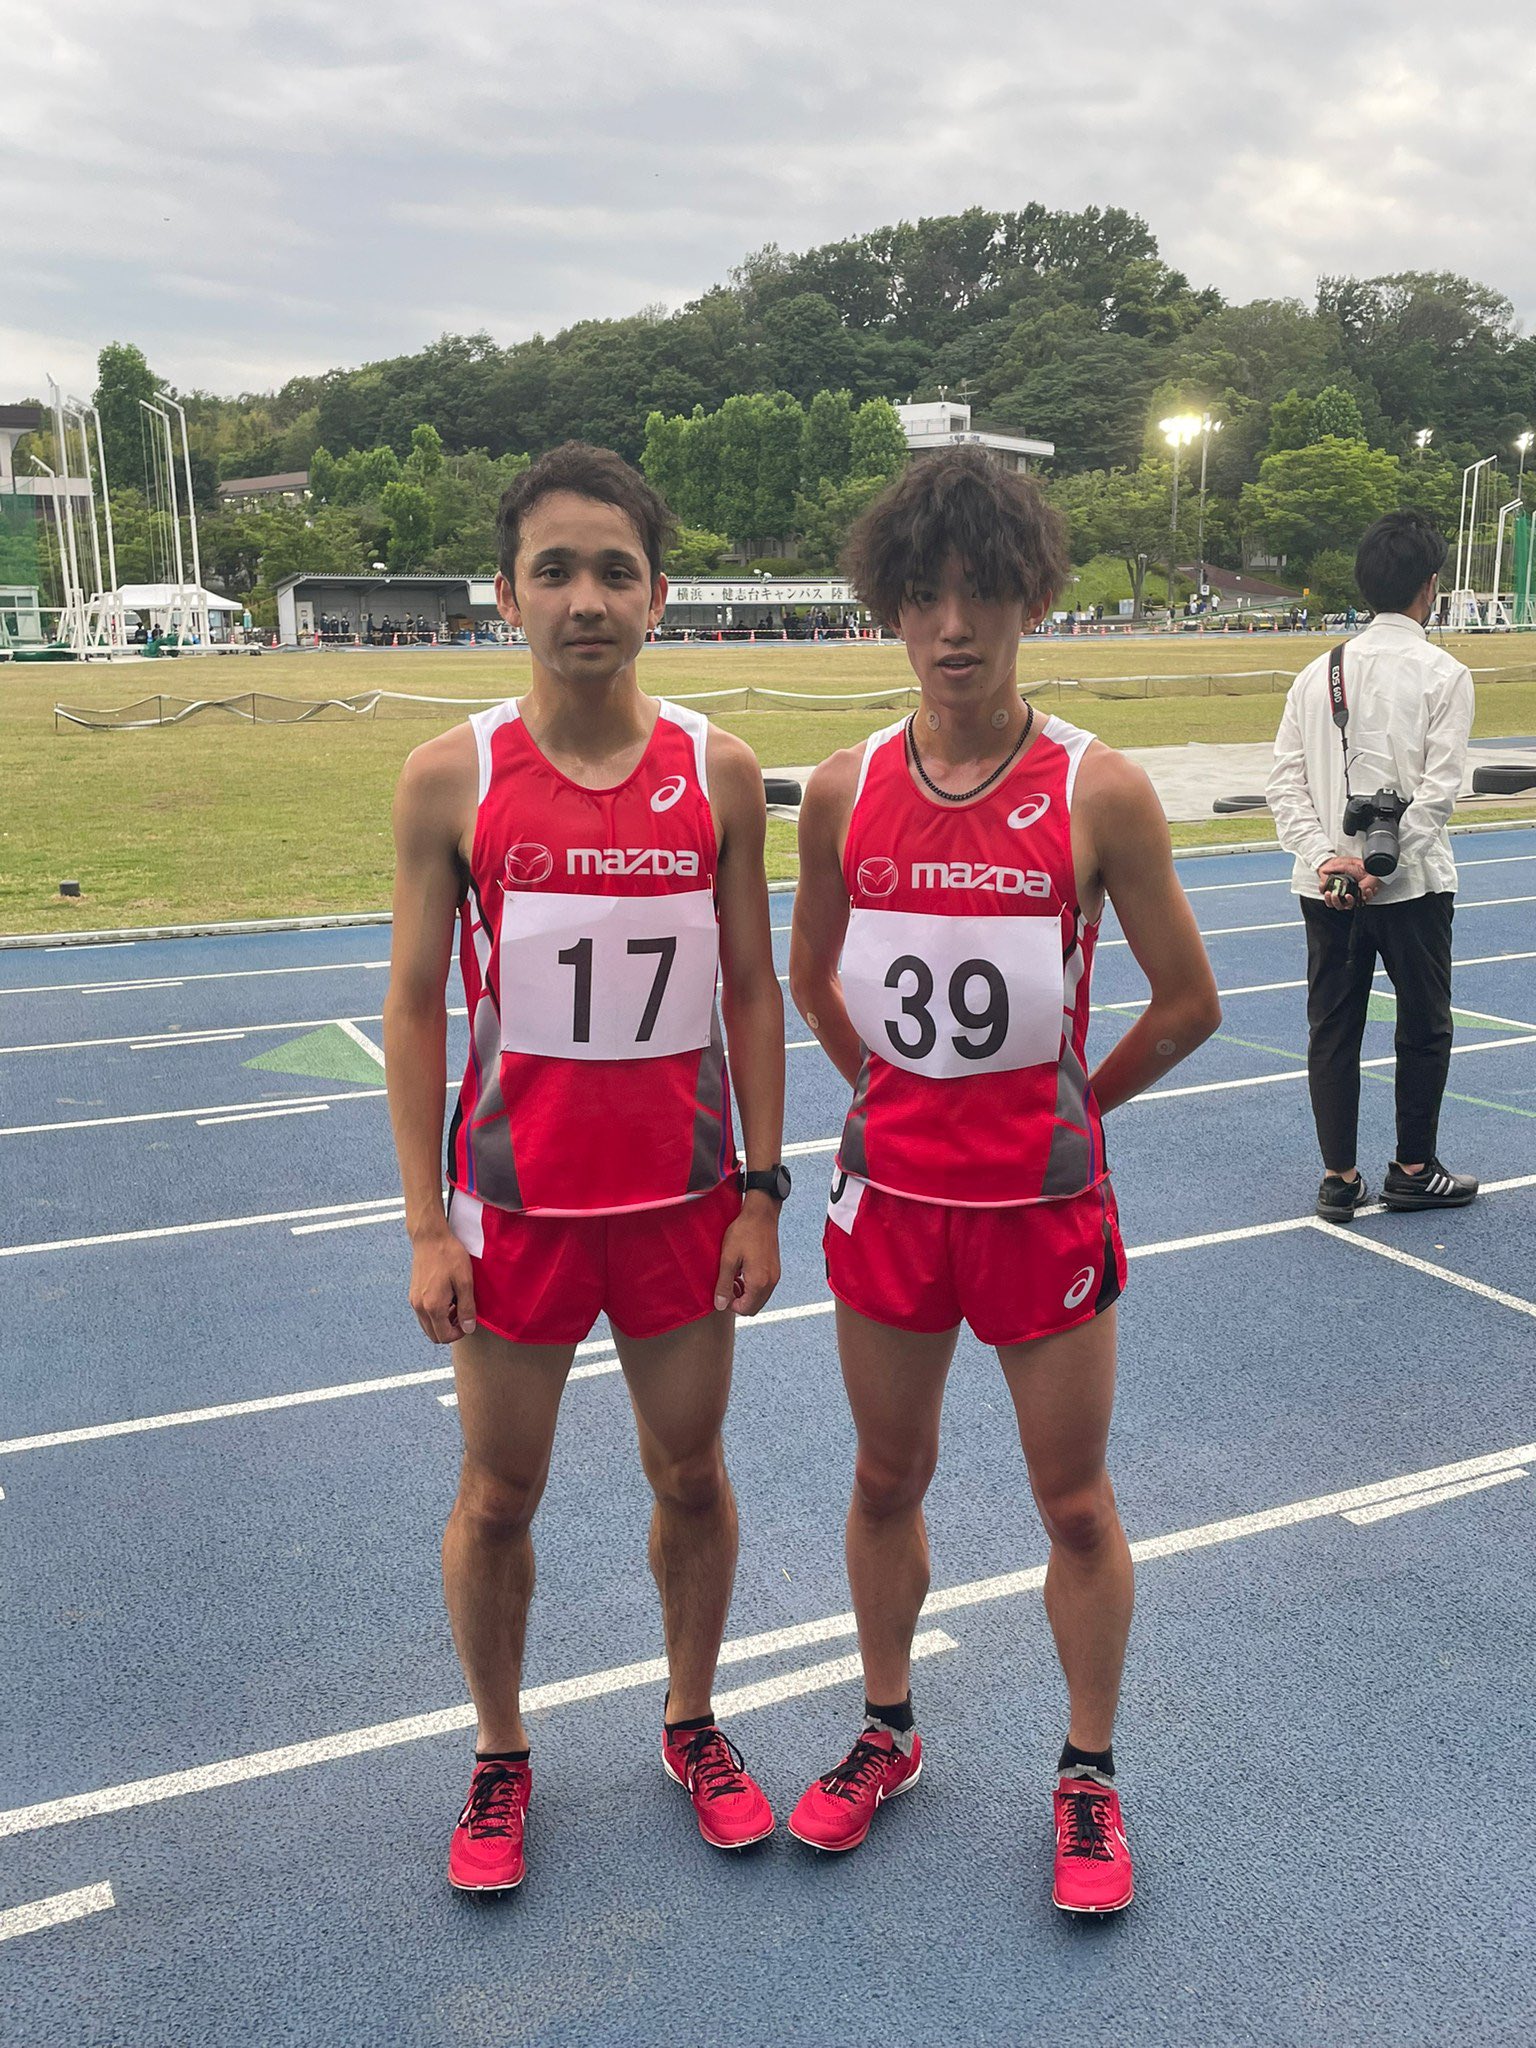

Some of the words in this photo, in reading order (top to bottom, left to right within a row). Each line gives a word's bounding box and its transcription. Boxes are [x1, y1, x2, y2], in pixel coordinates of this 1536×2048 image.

[1332, 665, 1341, 686] EOS
[1333, 686, 1343, 703] 60D
[558, 936, 677, 1043] 17
[884, 955, 1009, 1060] 39
